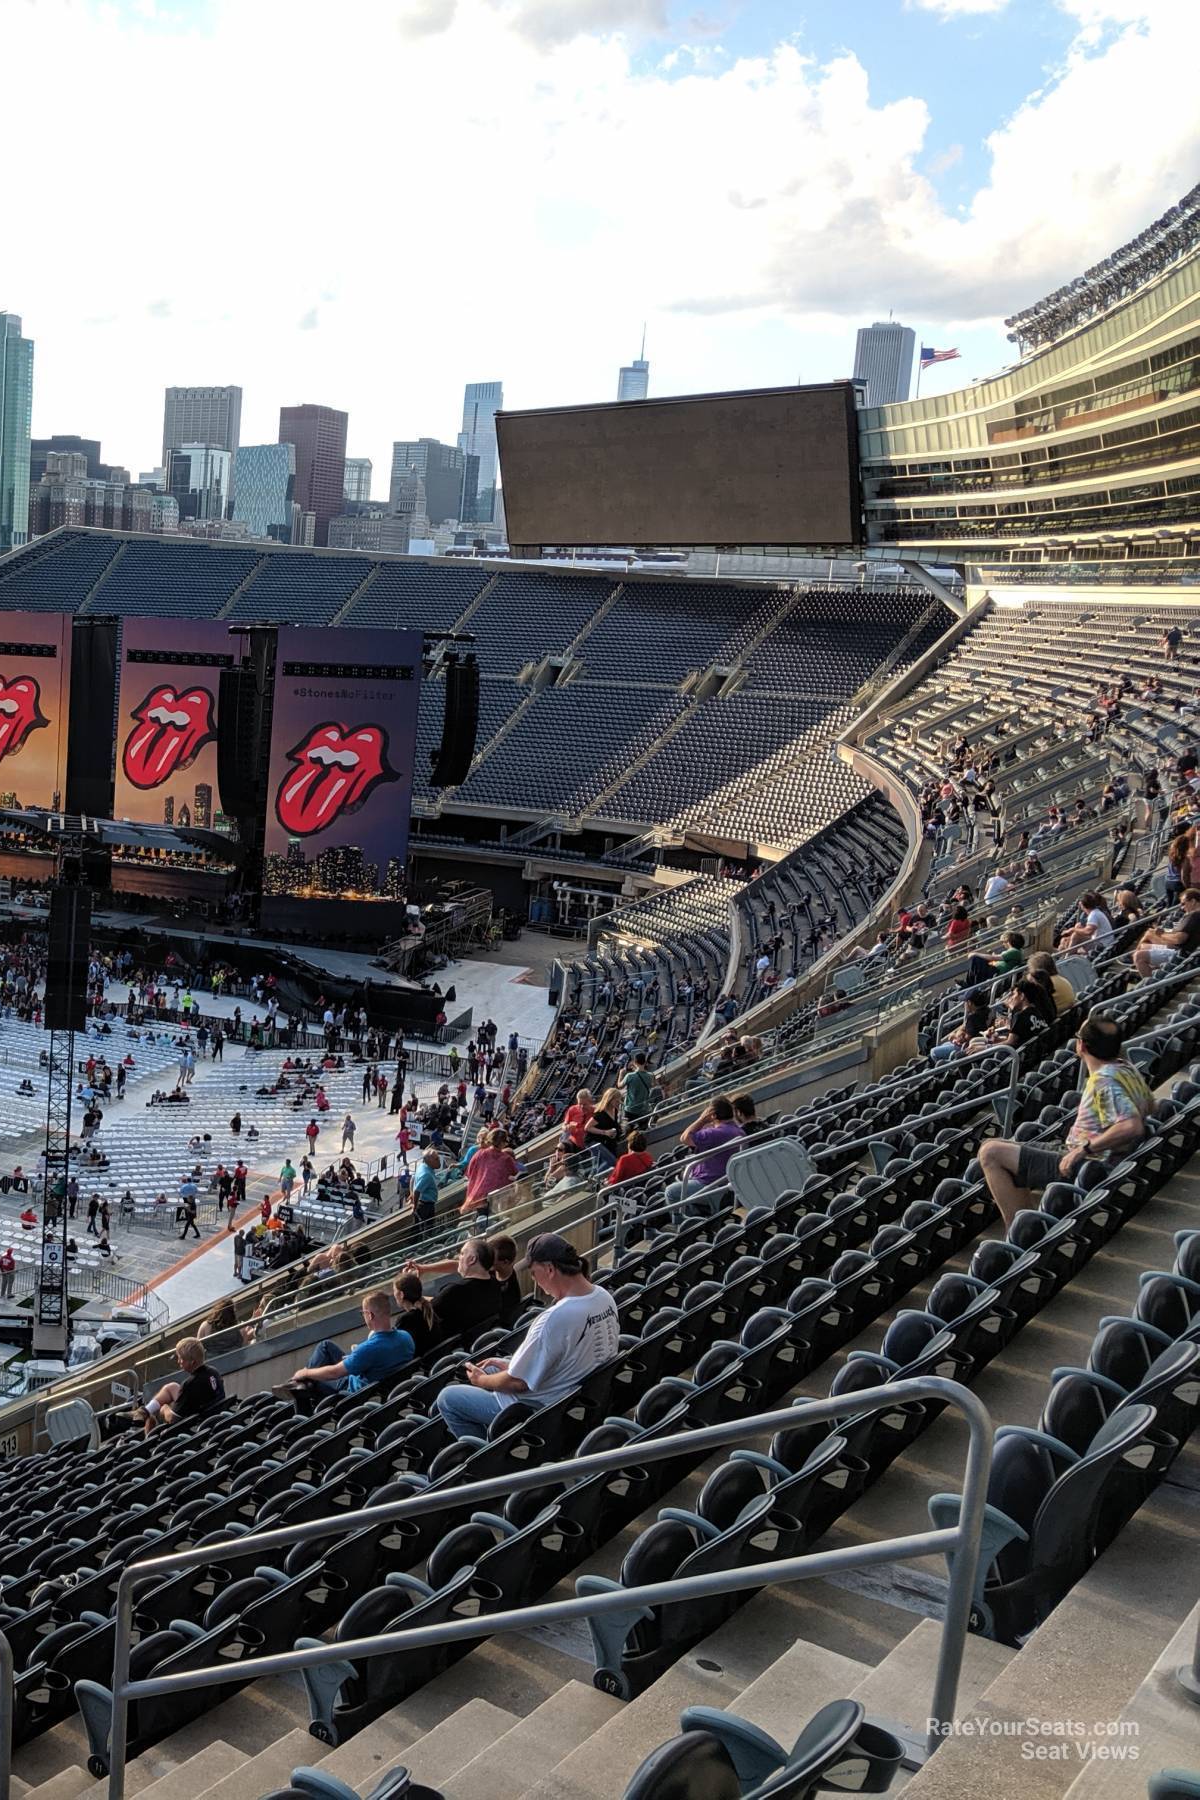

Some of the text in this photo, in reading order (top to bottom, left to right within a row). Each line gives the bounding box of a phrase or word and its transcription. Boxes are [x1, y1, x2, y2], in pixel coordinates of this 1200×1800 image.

[18, 1180, 25, 1190] A
[1, 1435, 17, 1457] 313
[604, 1677, 616, 1692] 13
[318, 1728, 328, 1739] 12
